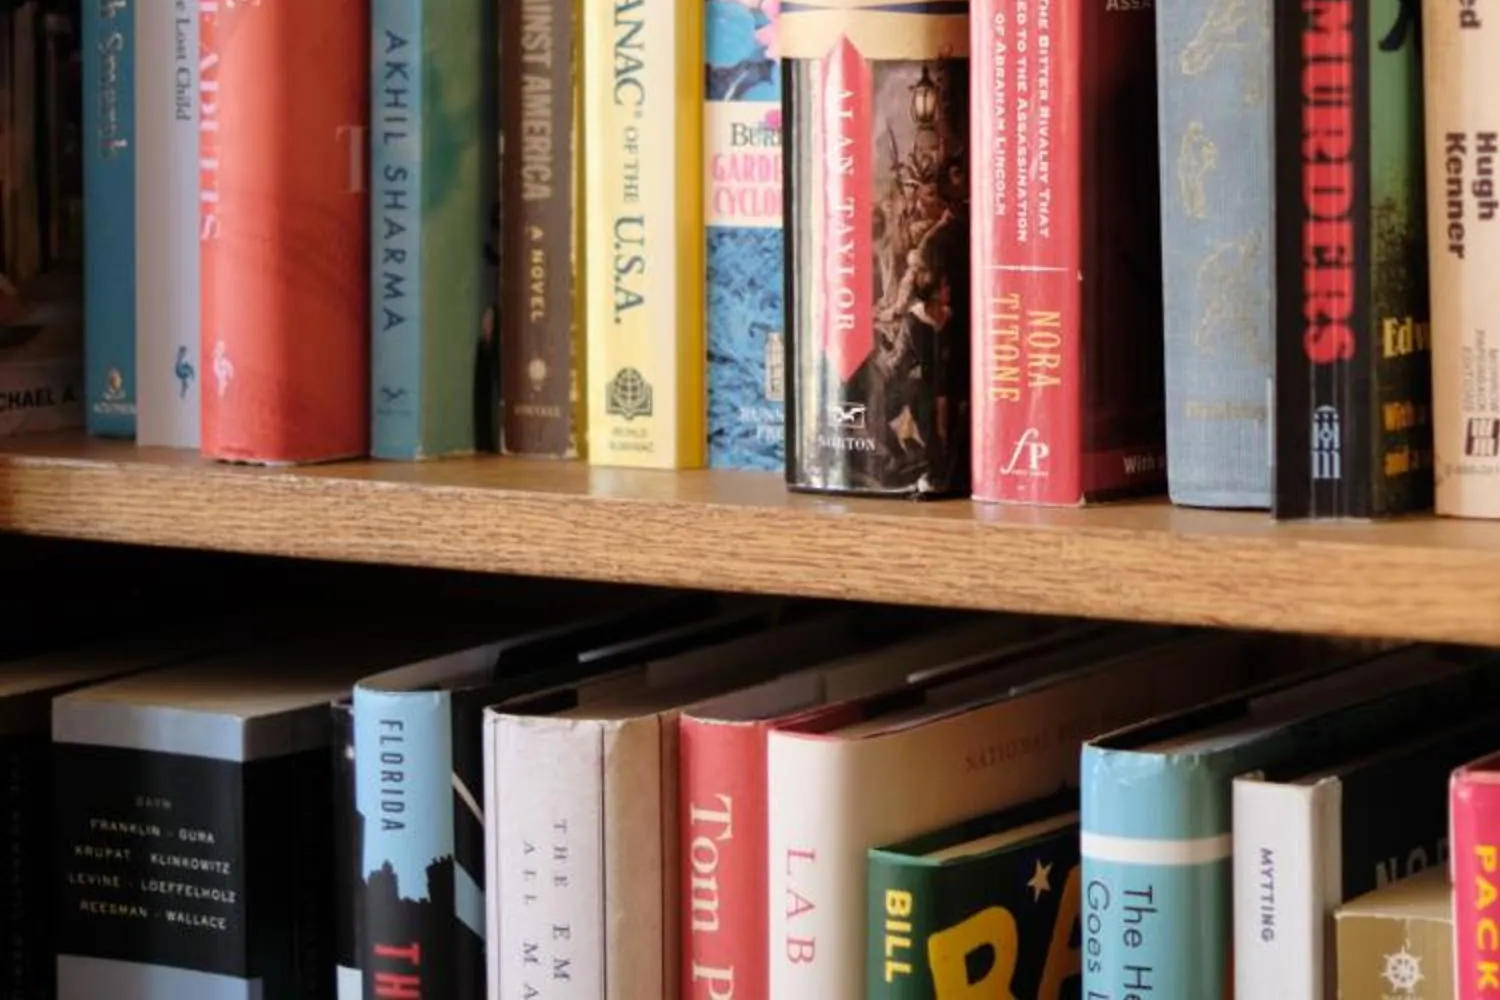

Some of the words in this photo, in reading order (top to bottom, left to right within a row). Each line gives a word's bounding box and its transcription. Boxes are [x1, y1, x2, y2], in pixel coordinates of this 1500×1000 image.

[175, 18, 191, 62] Lost
[993, 12, 1007, 37] OF
[1015, 30, 1029, 53] TO
[175, 66, 191, 121] Child
[382, 30, 410, 145] AKHIL
[993, 41, 1007, 131] ABRAHAM
[1015, 57, 1029, 92] THE
[1037, 35, 1051, 101] BITTER
[521, 75, 553, 200] AMERICA
[624, 126, 639, 153] OF
[829, 89, 855, 177] ALAN
[1015, 97, 1029, 244] ASSASSINATION
[1037, 106, 1051, 184] RIVALRY
[624, 157, 640, 201] THE
[712, 187, 783, 216] CYCLO
[993, 136, 1007, 217] LINCOLN
[1037, 188, 1051, 239] THAT
[1301, 0, 1355, 364] MURDERS
[1445, 131, 1468, 260] Kenner
[1471, 131, 1500, 221] Hugh
[382, 165, 409, 332] SHARMA
[525, 226, 543, 240] A
[613, 216, 645, 325] U.S.A.
[831, 197, 856, 332] TAYLOR
[531, 252, 545, 322] NOVEL
[987, 292, 1020, 403] TITONE
[1026, 310, 1062, 389] NORA
[818, 437, 877, 452] NORTON
[379, 719, 406, 832] FLORIDA
[74, 844, 131, 861] KRUPAT
[149, 853, 231, 876] KLINKOWITZ
[89, 817, 161, 838] FRANKLIN
[178, 827, 216, 845] GURA
[553, 818, 569, 888] THE
[689, 792, 735, 935] Tom
[68, 871, 120, 888] LEVINE
[140, 879, 237, 904] LOEFFELHOLZ
[522, 840, 538, 906] ALL
[785, 848, 817, 965] LAB
[1259, 847, 1276, 943] MYTTING
[79, 899, 149, 919] REESMAN
[165, 909, 227, 931] WALLACE
[884, 888, 914, 983] BILL
[1086, 880, 1111, 974] Goes
[1122, 885, 1159, 949] The
[1473, 844, 1500, 992] PACK
